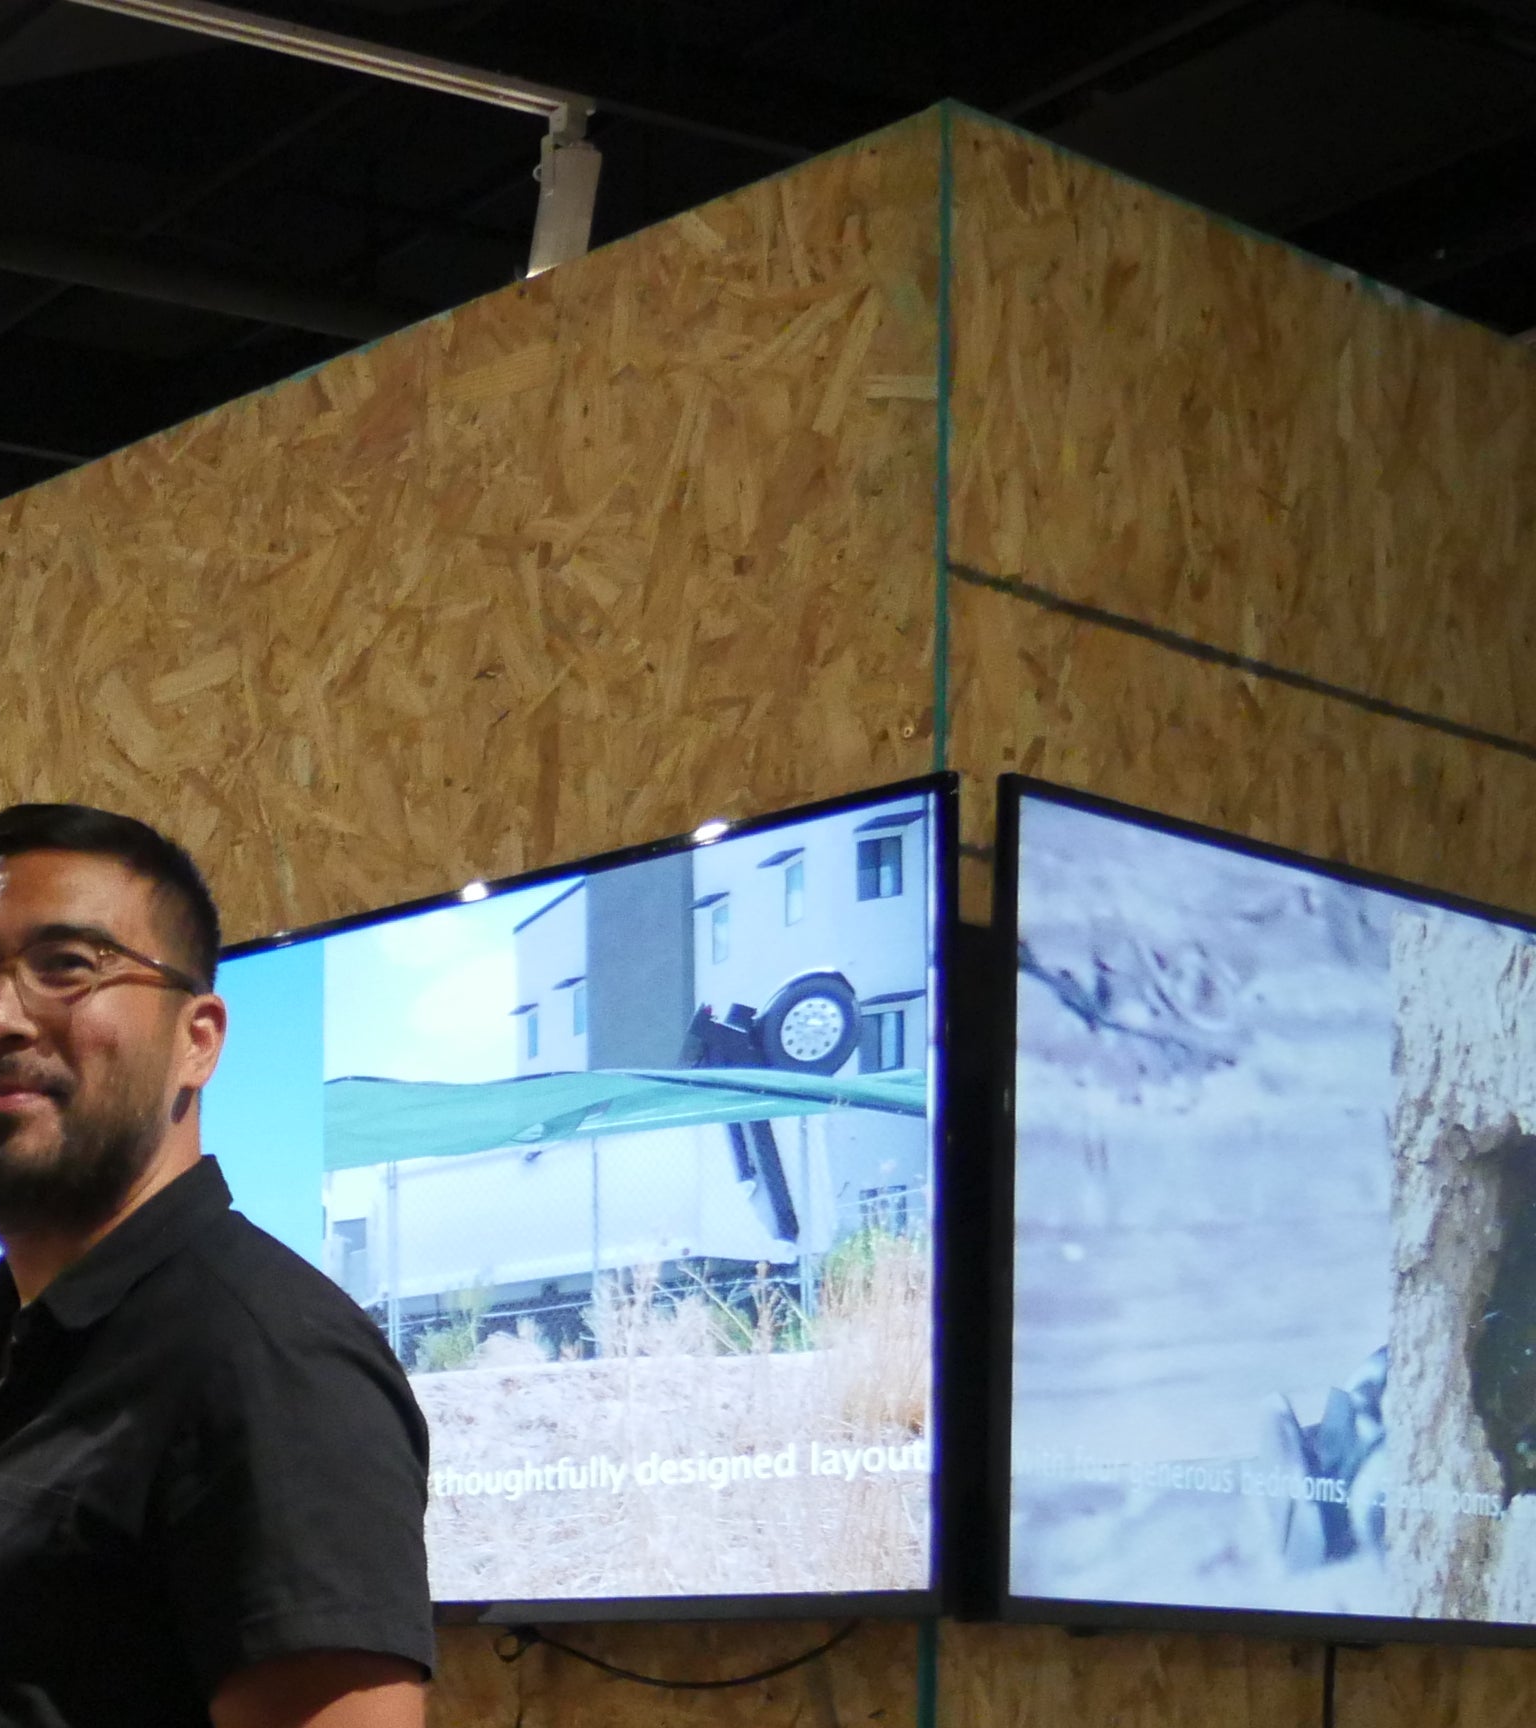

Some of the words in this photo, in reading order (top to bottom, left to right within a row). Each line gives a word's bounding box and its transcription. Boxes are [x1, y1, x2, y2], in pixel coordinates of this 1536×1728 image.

[433, 1454, 626, 1500] thoughtfully
[636, 1443, 798, 1489] designed
[1129, 1458, 1234, 1493] generous
